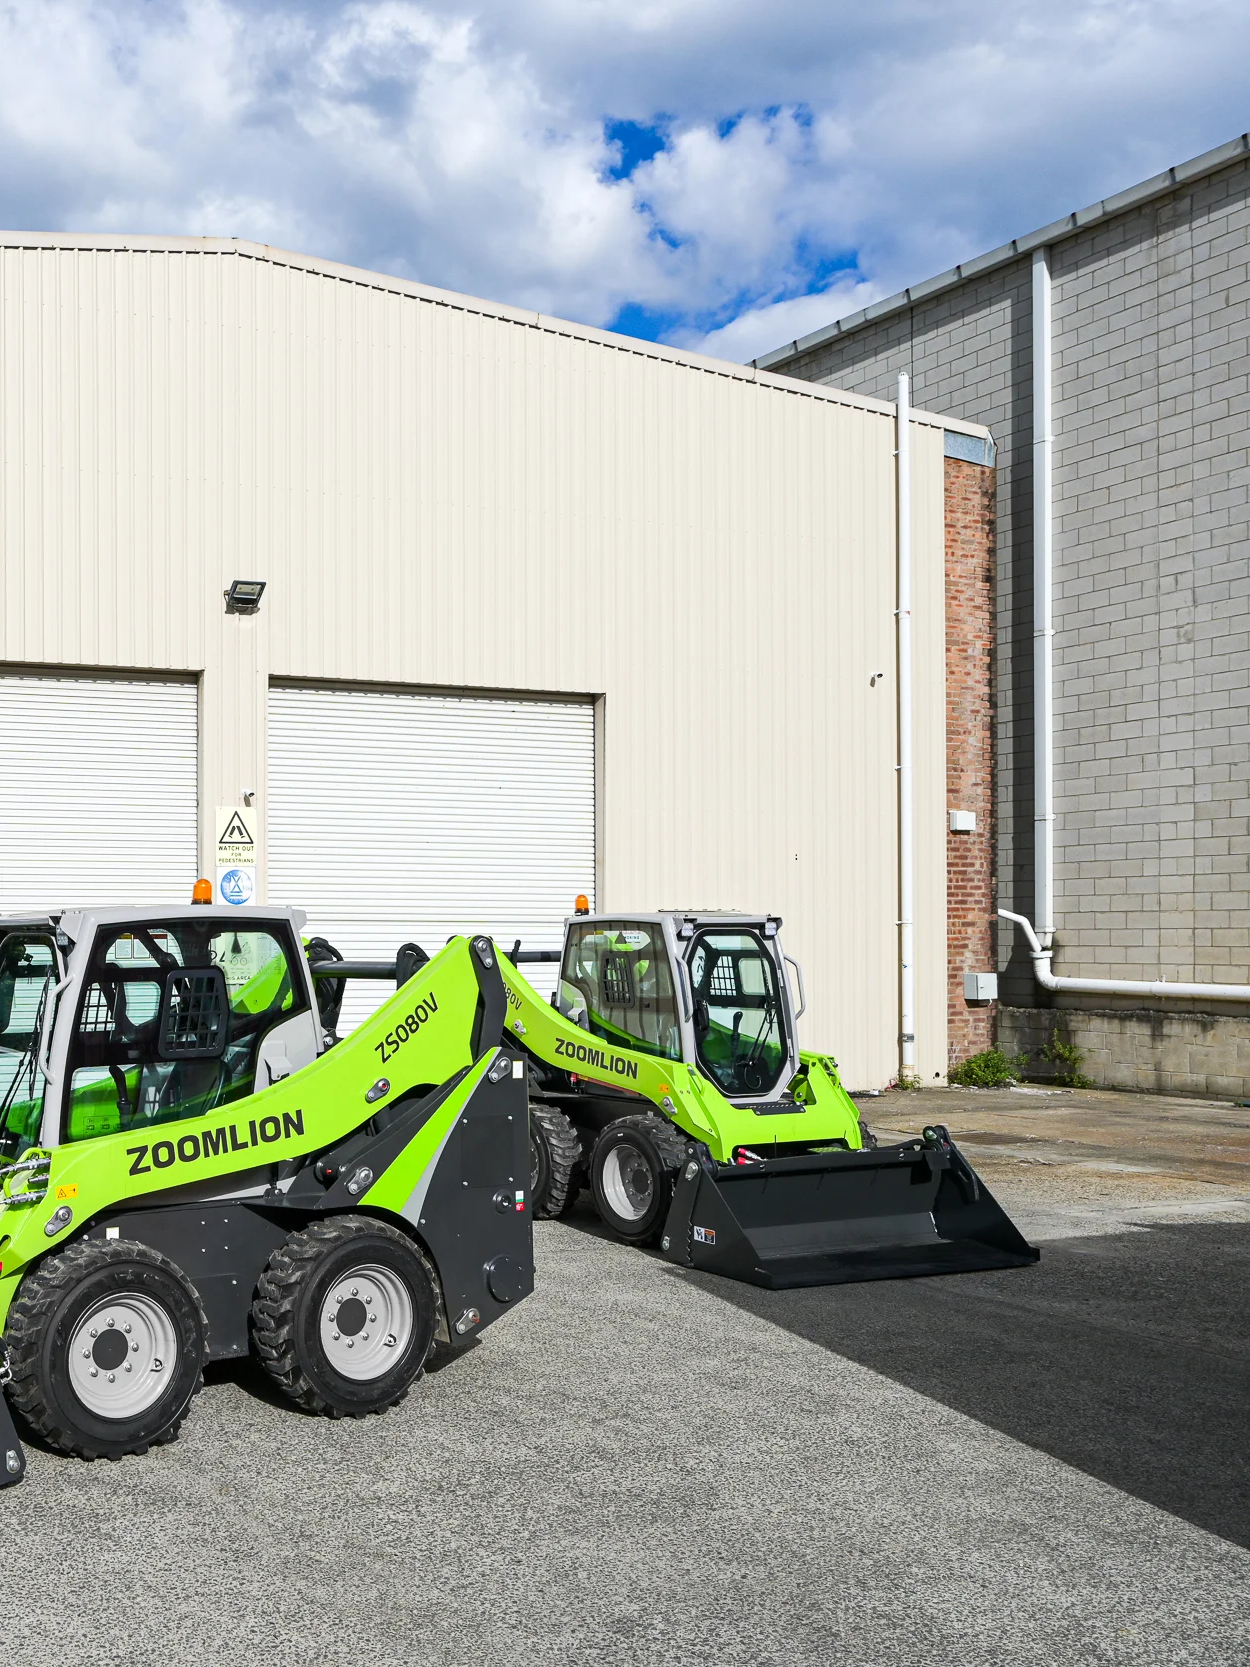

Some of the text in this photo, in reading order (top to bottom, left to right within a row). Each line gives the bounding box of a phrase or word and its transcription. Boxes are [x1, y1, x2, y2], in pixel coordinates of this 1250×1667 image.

[374, 991, 439, 1064] ZS080V
[554, 1037, 638, 1080] ZOOMLION
[126, 1109, 305, 1176] ZOOMLION
